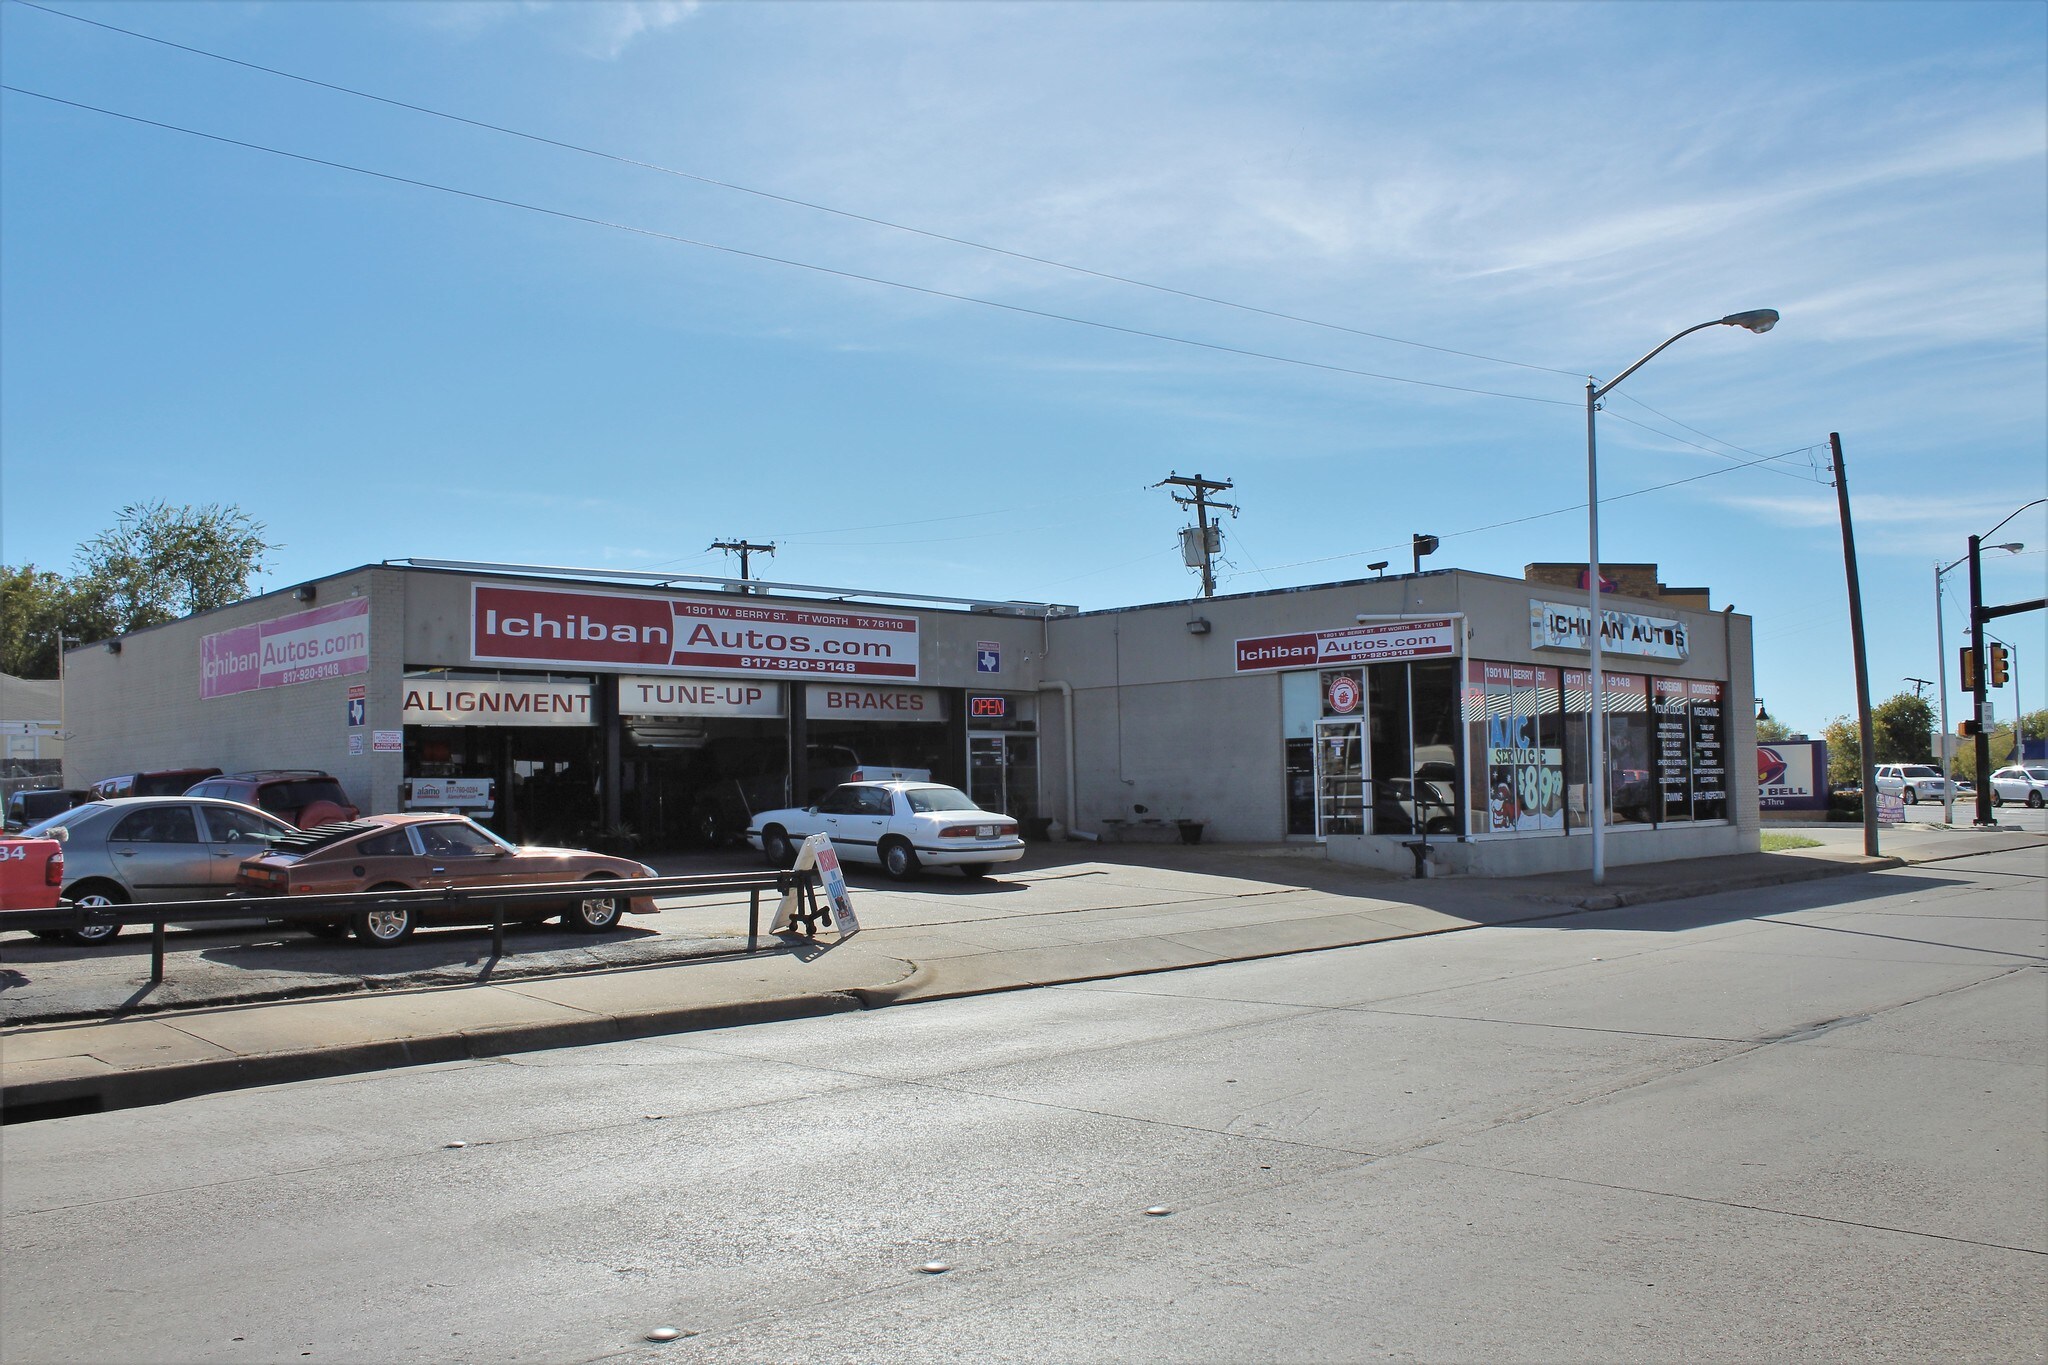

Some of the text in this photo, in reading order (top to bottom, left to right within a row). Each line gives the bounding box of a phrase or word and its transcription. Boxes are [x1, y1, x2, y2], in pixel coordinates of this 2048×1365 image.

[685, 605, 903, 629] 1901 W. BERRY ST. FT WORTH TX 76110
[486, 609, 668, 645] Ichiban
[1550, 614, 1685, 647] ICHIAN AUTOS
[687, 623, 892, 658] Autos.com
[1325, 635, 1436, 653] Autos.com
[263, 632, 364, 667] Autos.com
[1240, 644, 1316, 661] Ichiban
[1350, 649, 1415, 660] 817-920-9148
[203, 651, 259, 679] Ichiban
[741, 657, 856, 673] 817-920-9148
[283, 663, 339, 684] 817-920-9148
[1486, 667, 1502, 679] 1901
[1513, 669, 1534, 680] BERRY
[1537, 670, 1546, 681] ST.
[1564, 671, 1583, 686] (817)
[637, 684, 762, 706] TUNE-UP
[1657, 681, 1683, 693] FOREIGN
[1692, 684, 1720, 695] DOMESTIC
[403, 690, 591, 713] ALIGNMENT
[826, 691, 924, 712] BRAKES
[973, 699, 1004, 715] OPEN
[1655, 704, 1686, 715] YOUR LOCAL
[1694, 707, 1720, 717] MECHANIC
[1490, 712, 1530, 749] A/C
[1495, 749, 1547, 765] SERVICE
[417, 786, 440, 795] alamo
[1663, 792, 1683, 802] TOWING
[1768, 787, 1808, 796] BELL
[1767, 798, 1785, 806] Thru
